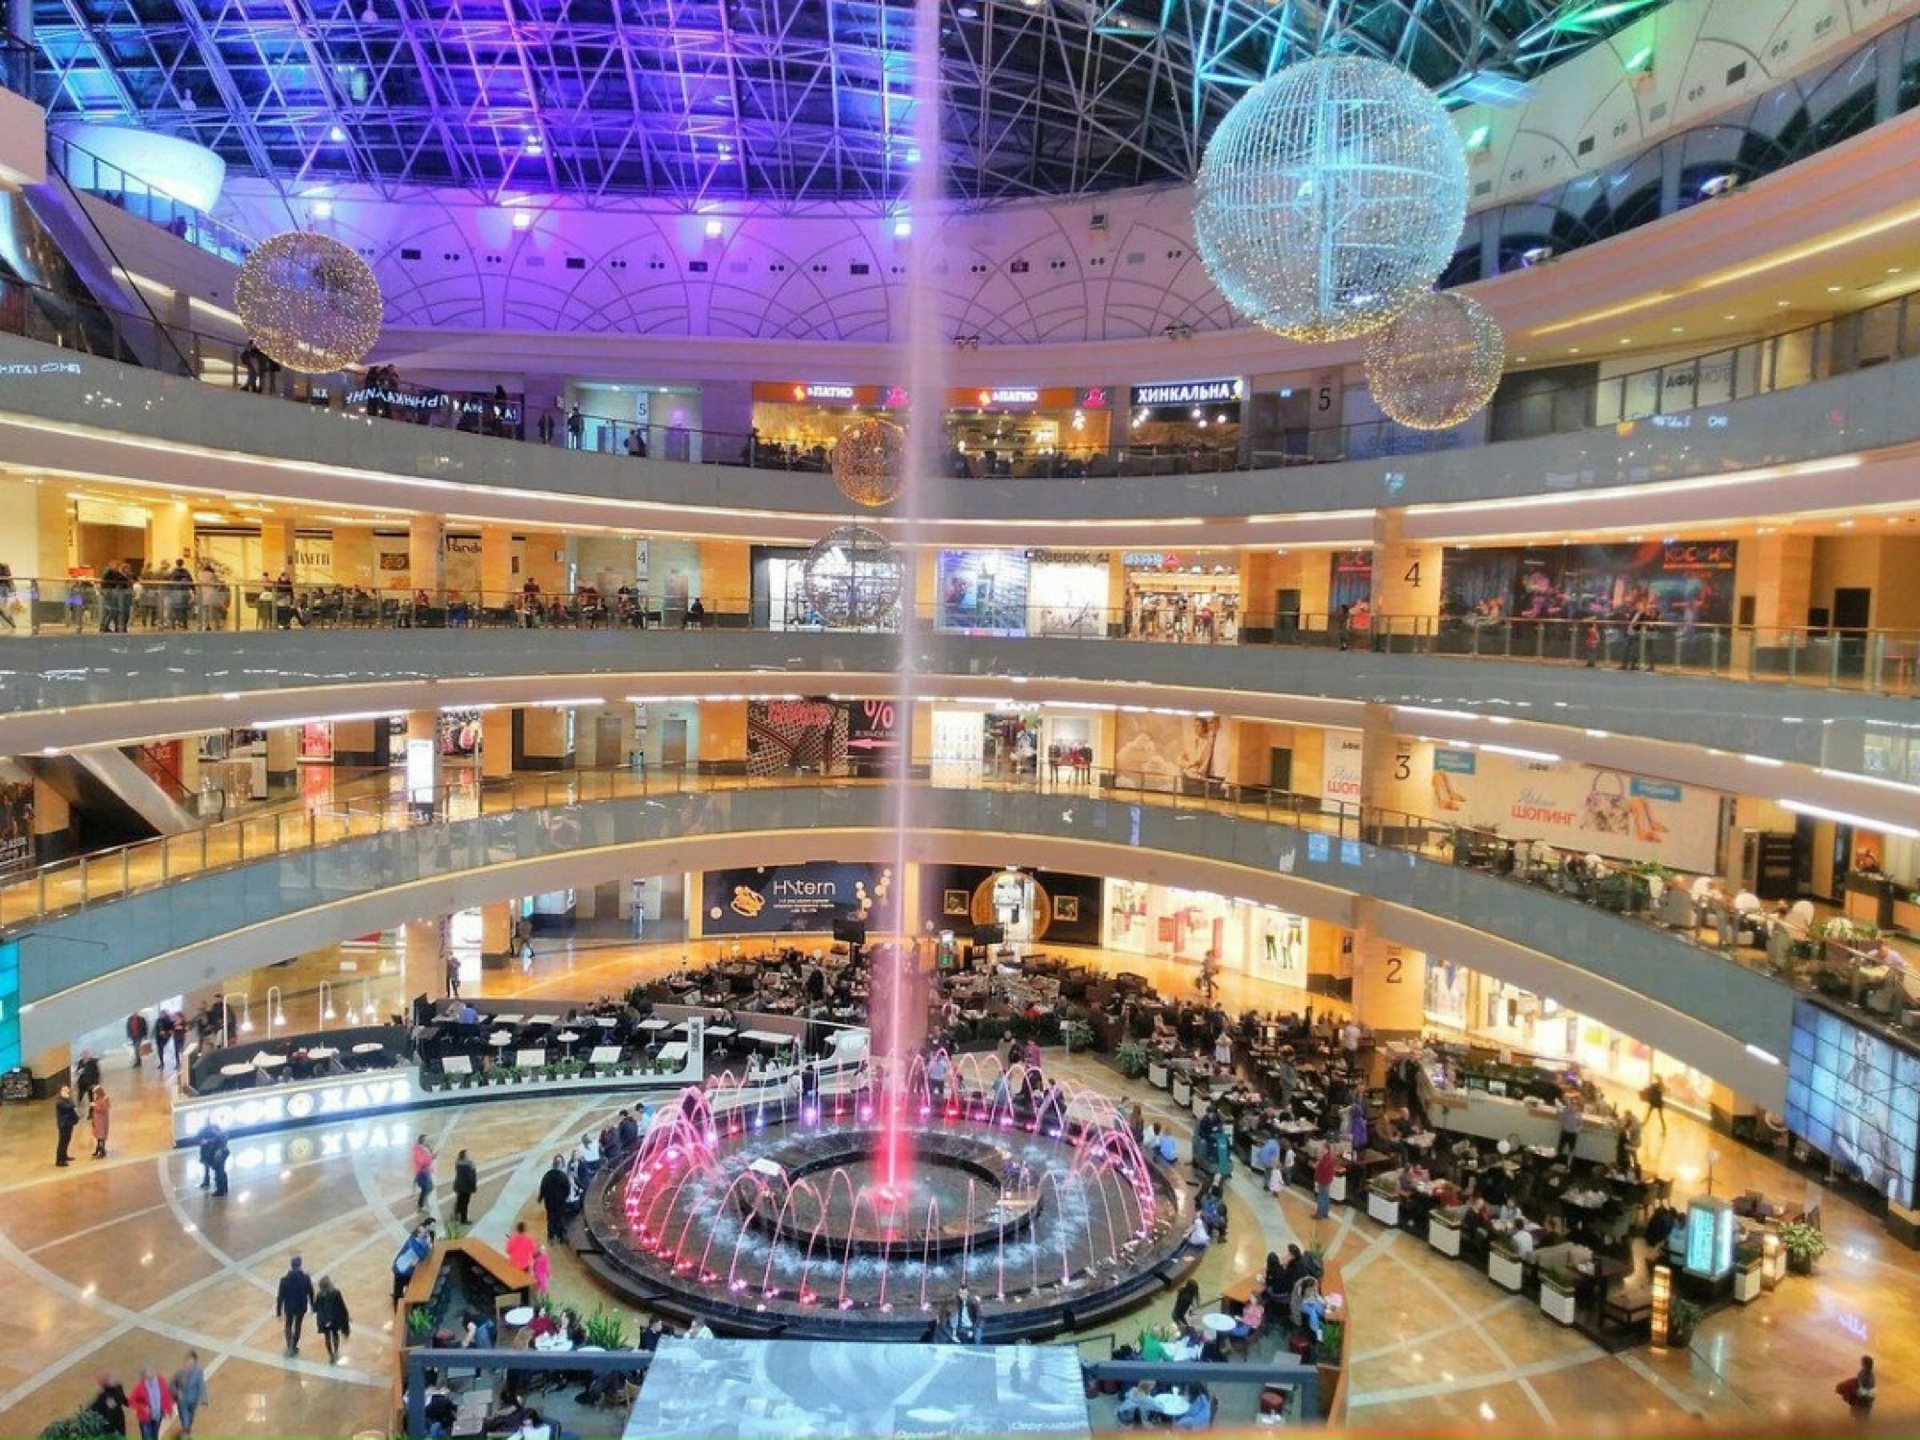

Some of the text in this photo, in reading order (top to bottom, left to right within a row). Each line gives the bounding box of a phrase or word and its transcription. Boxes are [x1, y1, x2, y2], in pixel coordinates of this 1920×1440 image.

[1319, 387, 1331, 411] 5
[1404, 561, 1421, 588] 4
[1395, 755, 1411, 780] 3
[1512, 804, 1576, 826] ШОПИНГ
[1386, 957, 1402, 983] 2
